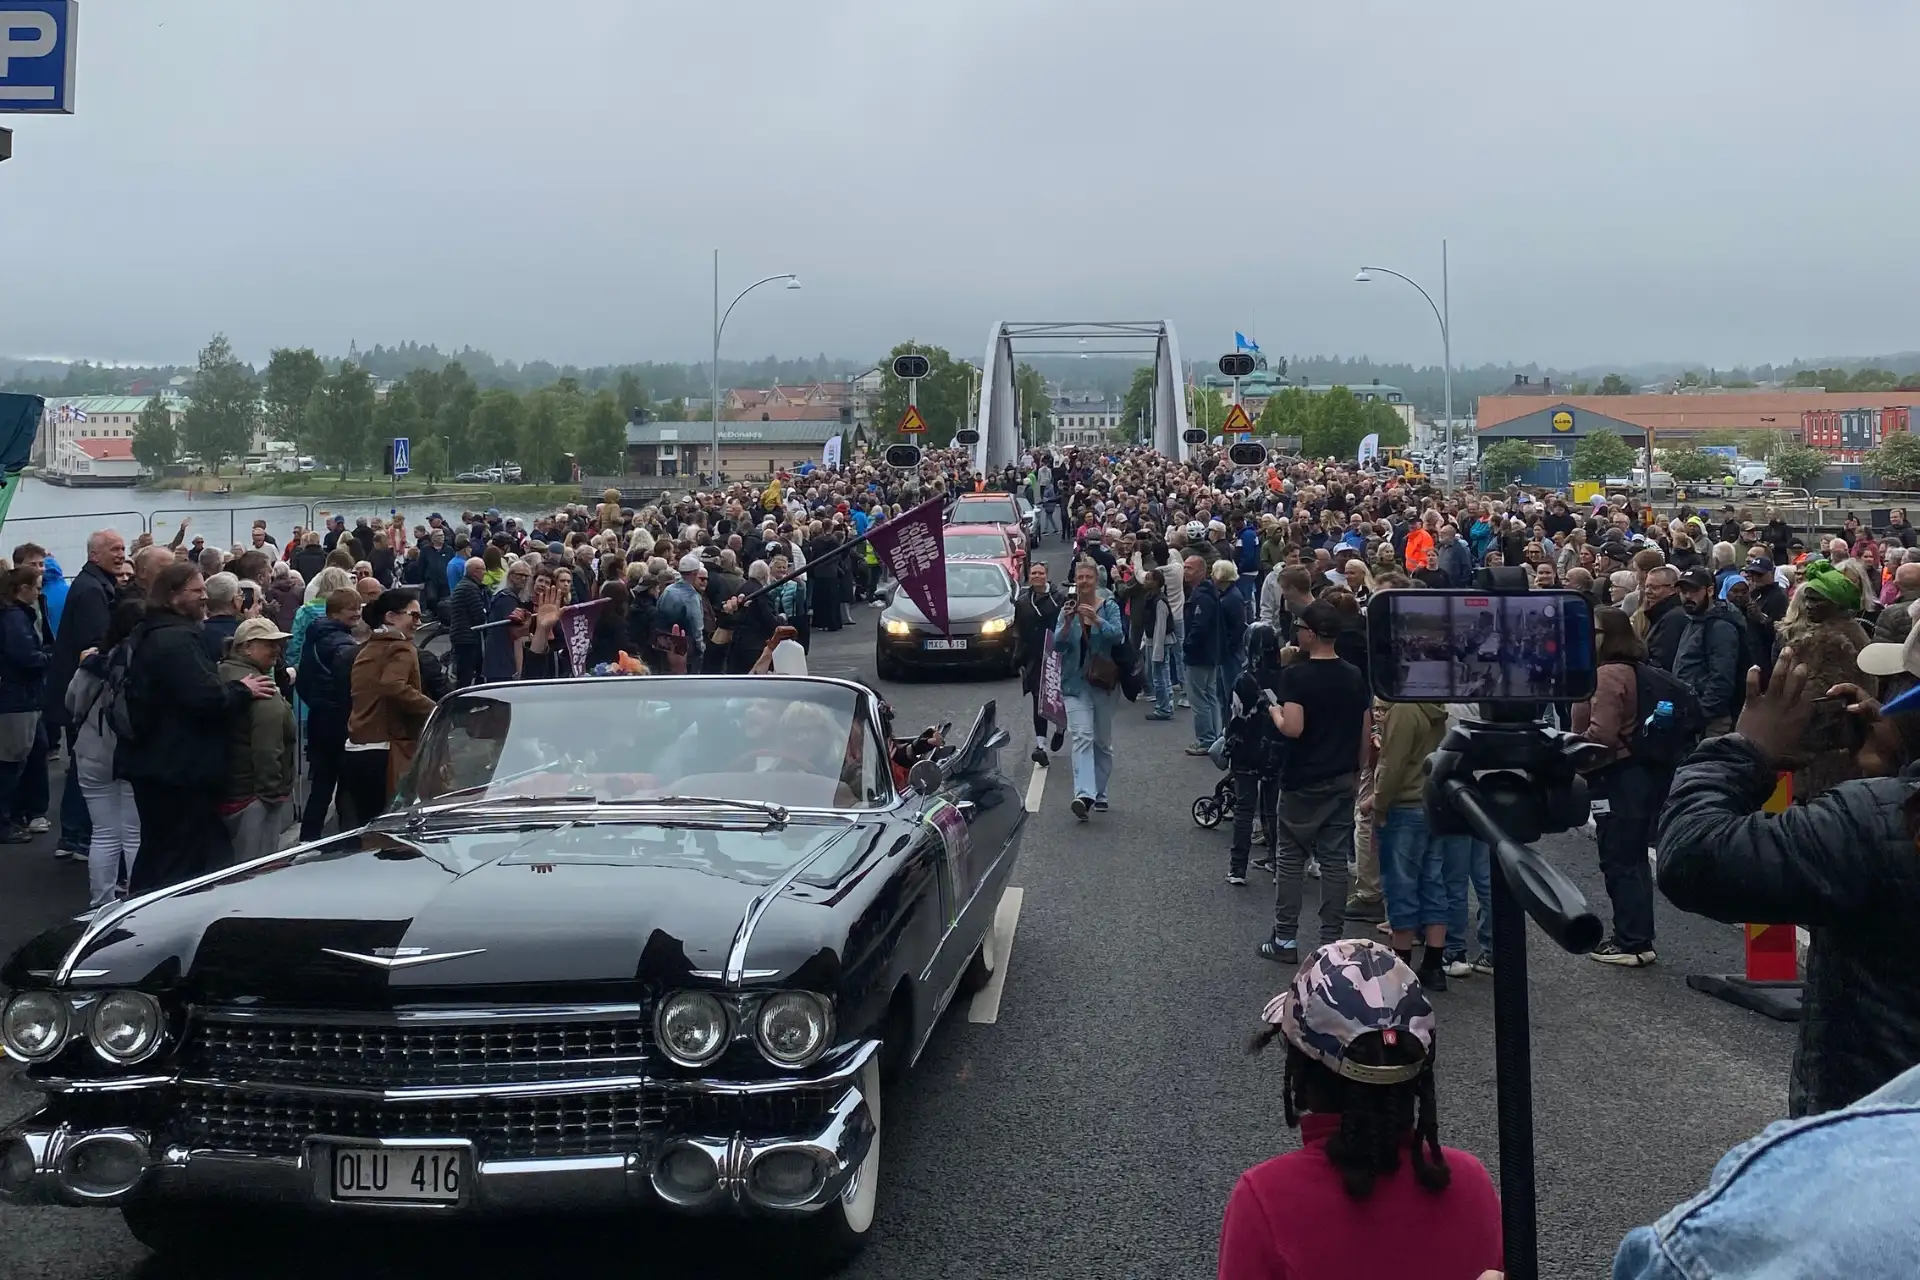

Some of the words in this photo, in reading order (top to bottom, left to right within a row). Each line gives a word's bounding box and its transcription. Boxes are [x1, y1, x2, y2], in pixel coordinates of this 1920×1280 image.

[0, 11, 57, 77] P
[908, 521, 931, 572] SOMMAR
[923, 536, 940, 560] MID
[928, 640, 944, 649] MXC
[339, 1153, 388, 1191] OLU
[410, 1155, 459, 1192] 416
